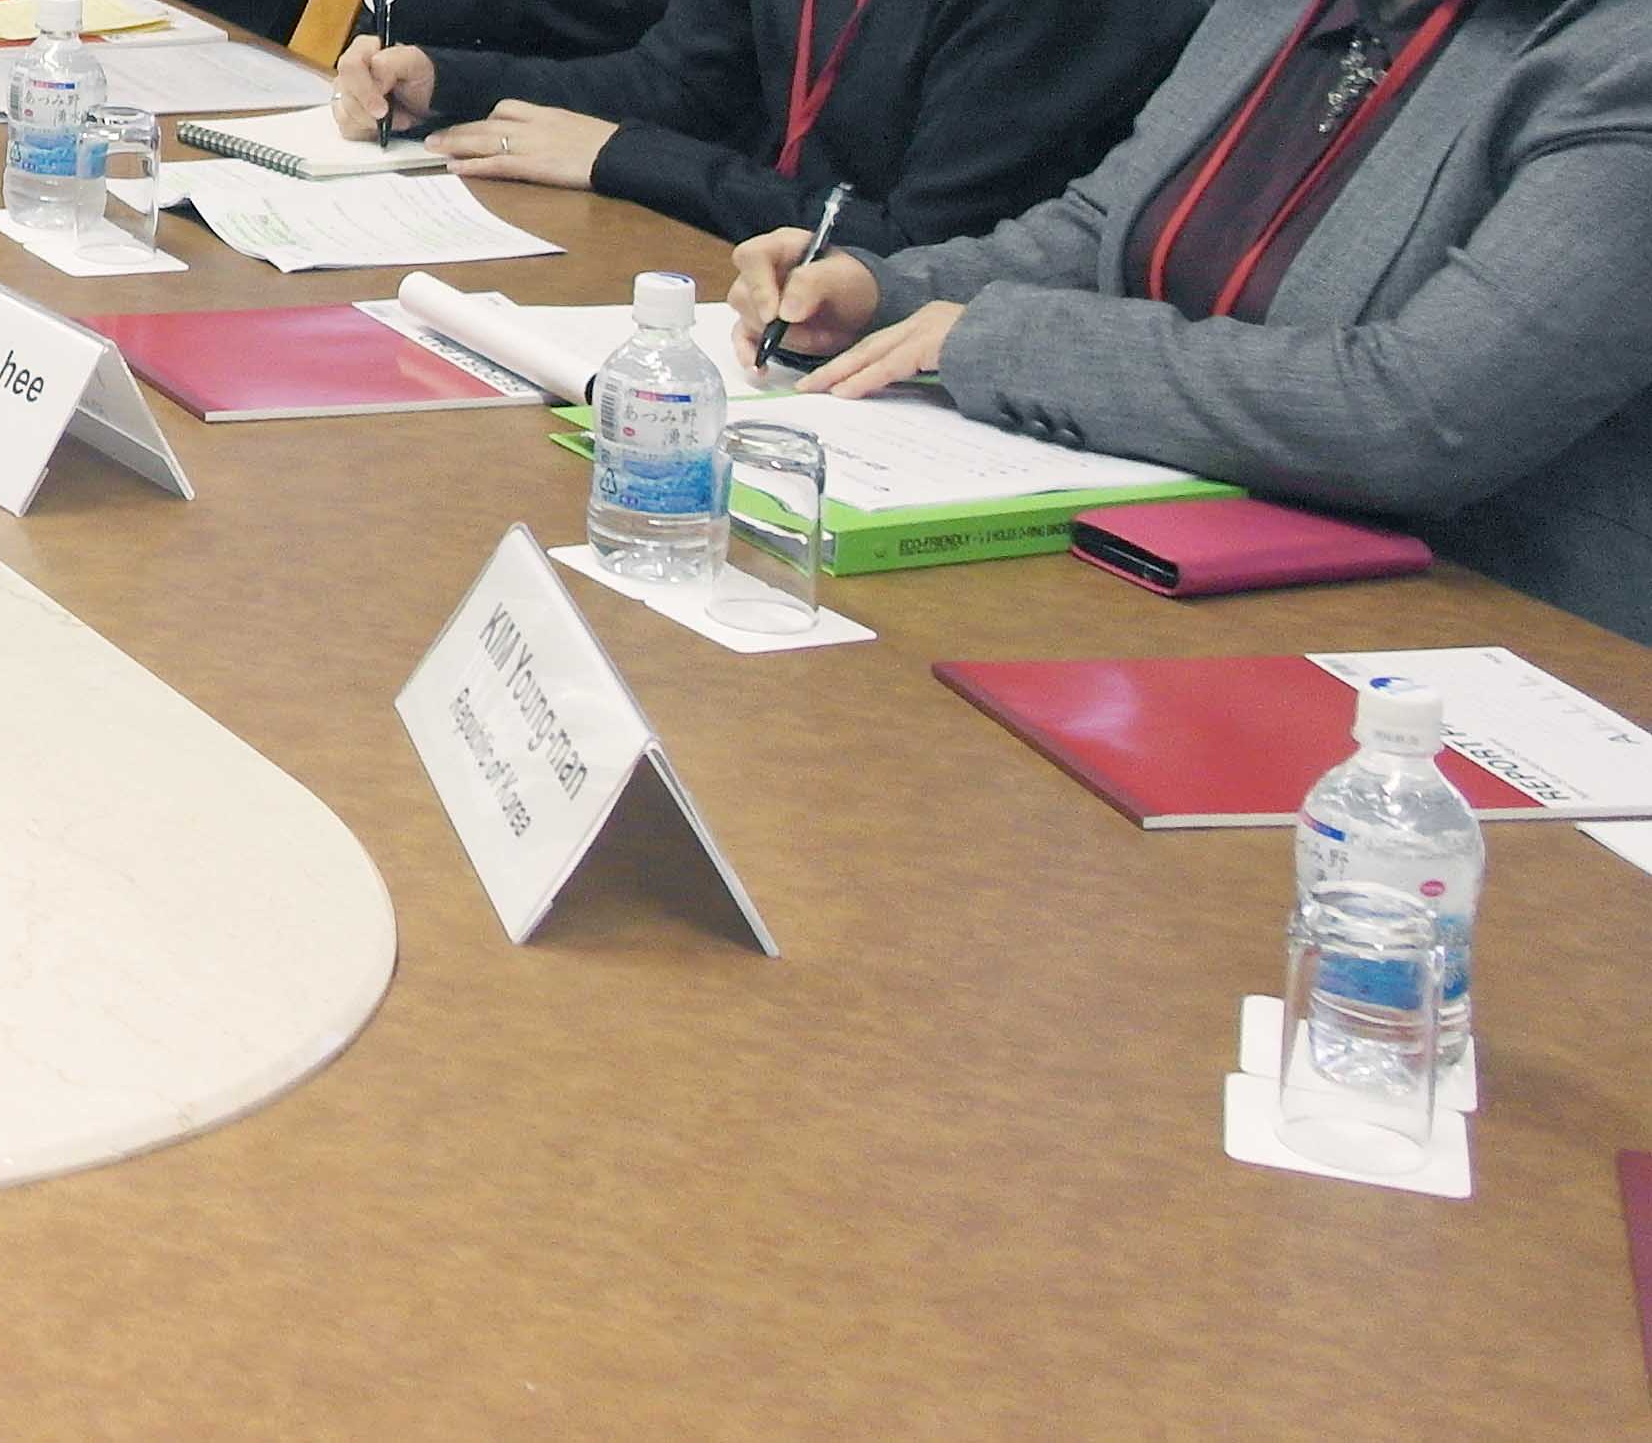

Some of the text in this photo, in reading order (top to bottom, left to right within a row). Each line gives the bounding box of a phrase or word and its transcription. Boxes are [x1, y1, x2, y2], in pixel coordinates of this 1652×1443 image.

[479, 602, 588, 801] KIM Young-man
[1452, 740, 1571, 800] REPORT
